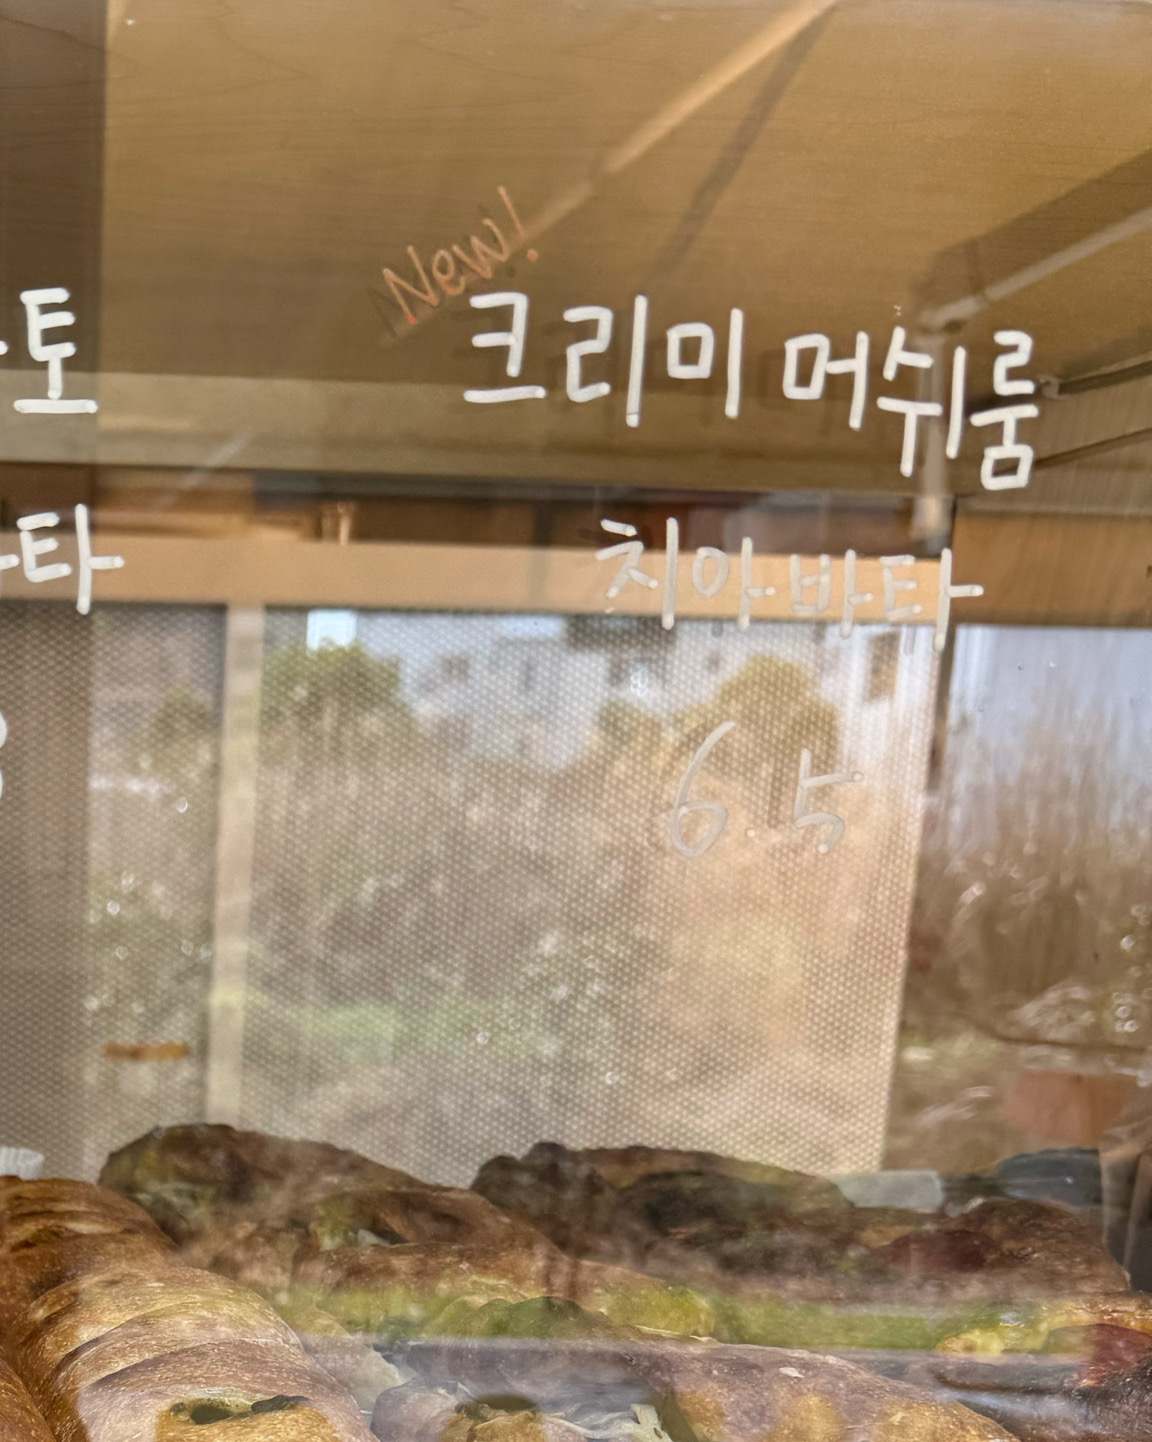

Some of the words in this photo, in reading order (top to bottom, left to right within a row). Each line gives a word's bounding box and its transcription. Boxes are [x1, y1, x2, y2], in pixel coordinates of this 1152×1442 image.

[382, 185, 539, 325] New!
[463, 292, 744, 427] 크리미
[783, 325, 1040, 490] 머쉬룸
[595, 517, 985, 652] 치아바타
[668, 721, 865, 858] 6.5
